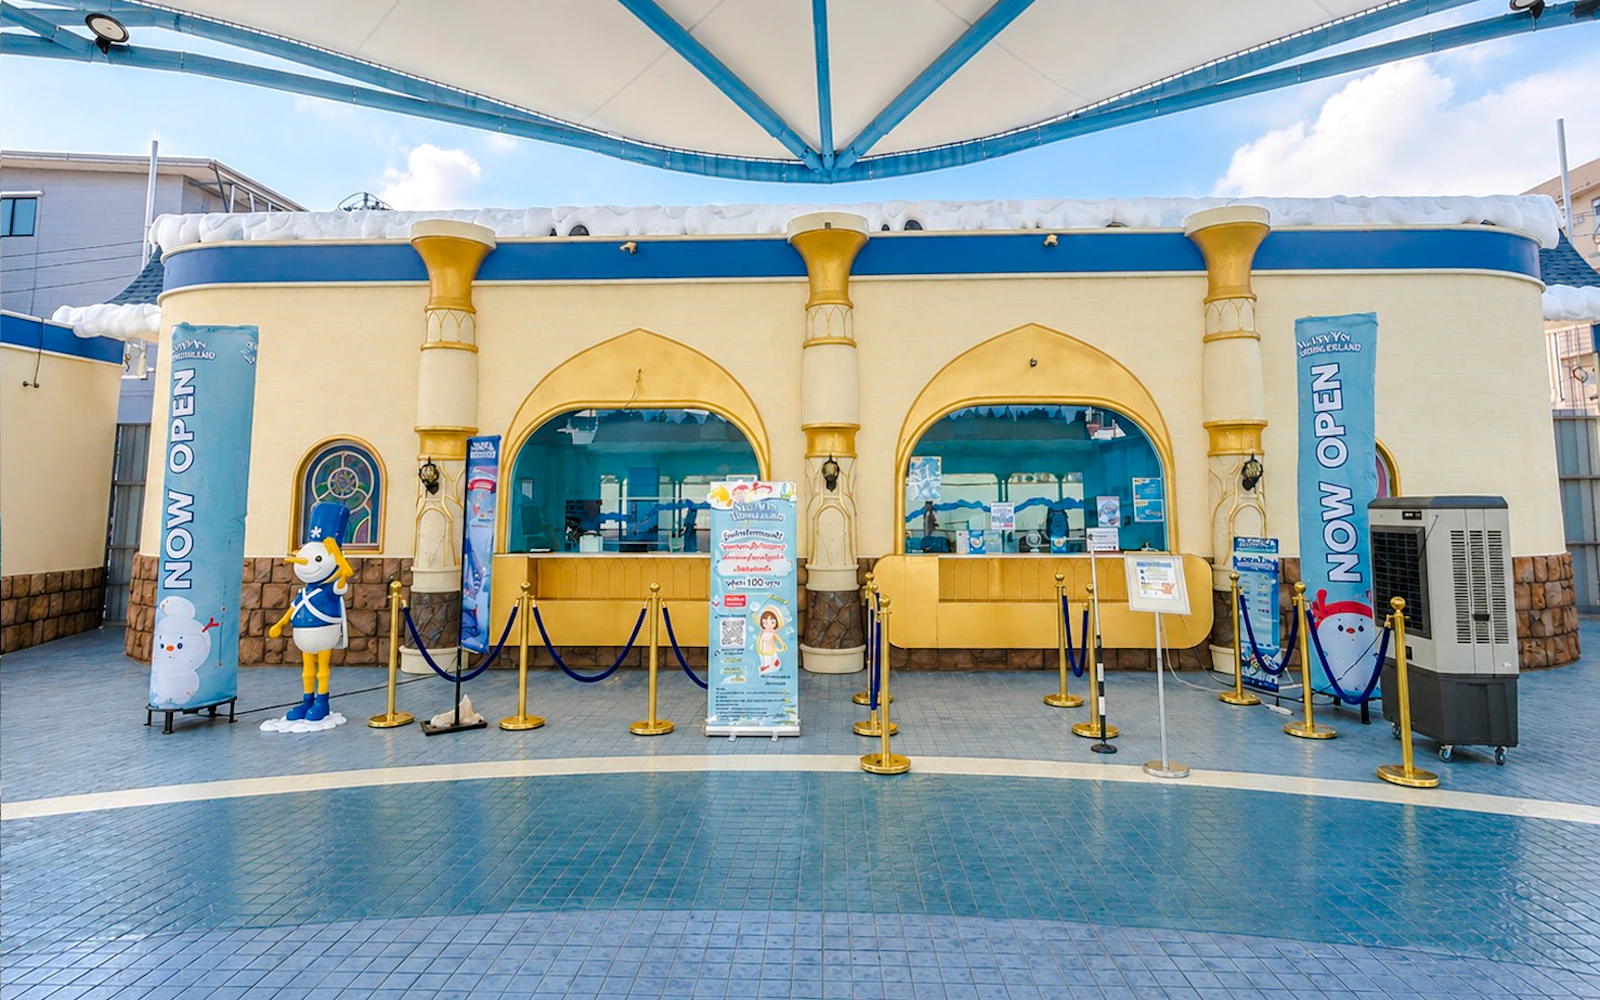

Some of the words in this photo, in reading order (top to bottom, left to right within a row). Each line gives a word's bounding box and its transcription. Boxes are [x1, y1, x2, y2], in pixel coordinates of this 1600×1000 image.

[169, 367, 196, 474] OPEN
[1311, 362, 1349, 469] OPEN
[163, 489, 195, 590] NOW
[747, 578, 764, 587] 100
[1319, 481, 1363, 583] NOW
